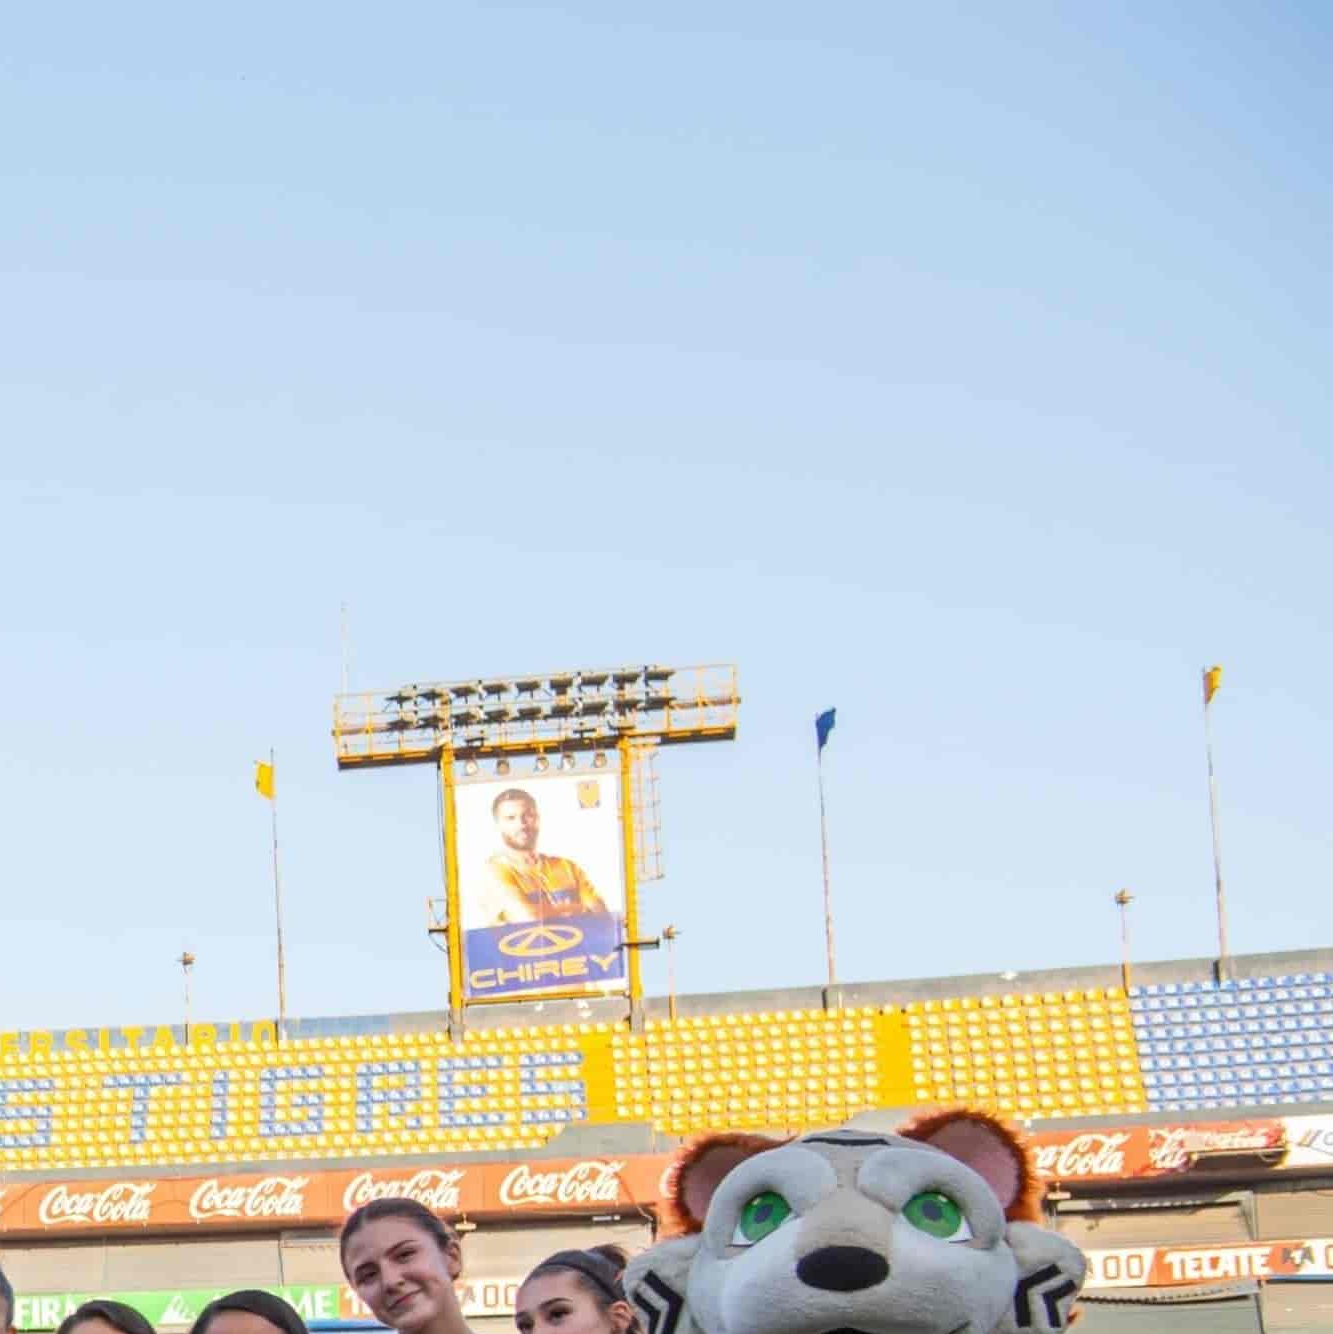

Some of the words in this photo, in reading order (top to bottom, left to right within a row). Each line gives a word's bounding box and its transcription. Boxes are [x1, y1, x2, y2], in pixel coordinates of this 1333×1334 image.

[469, 951, 619, 989] CHIREY
[102, 1051, 586, 1144] TIGRES
[38, 1182, 157, 1224] Coca-Cola
[189, 1176, 311, 1218] Coca-Cola
[499, 1161, 626, 1205] Coca-Cola
[1164, 1250, 1269, 1280] TECATE
